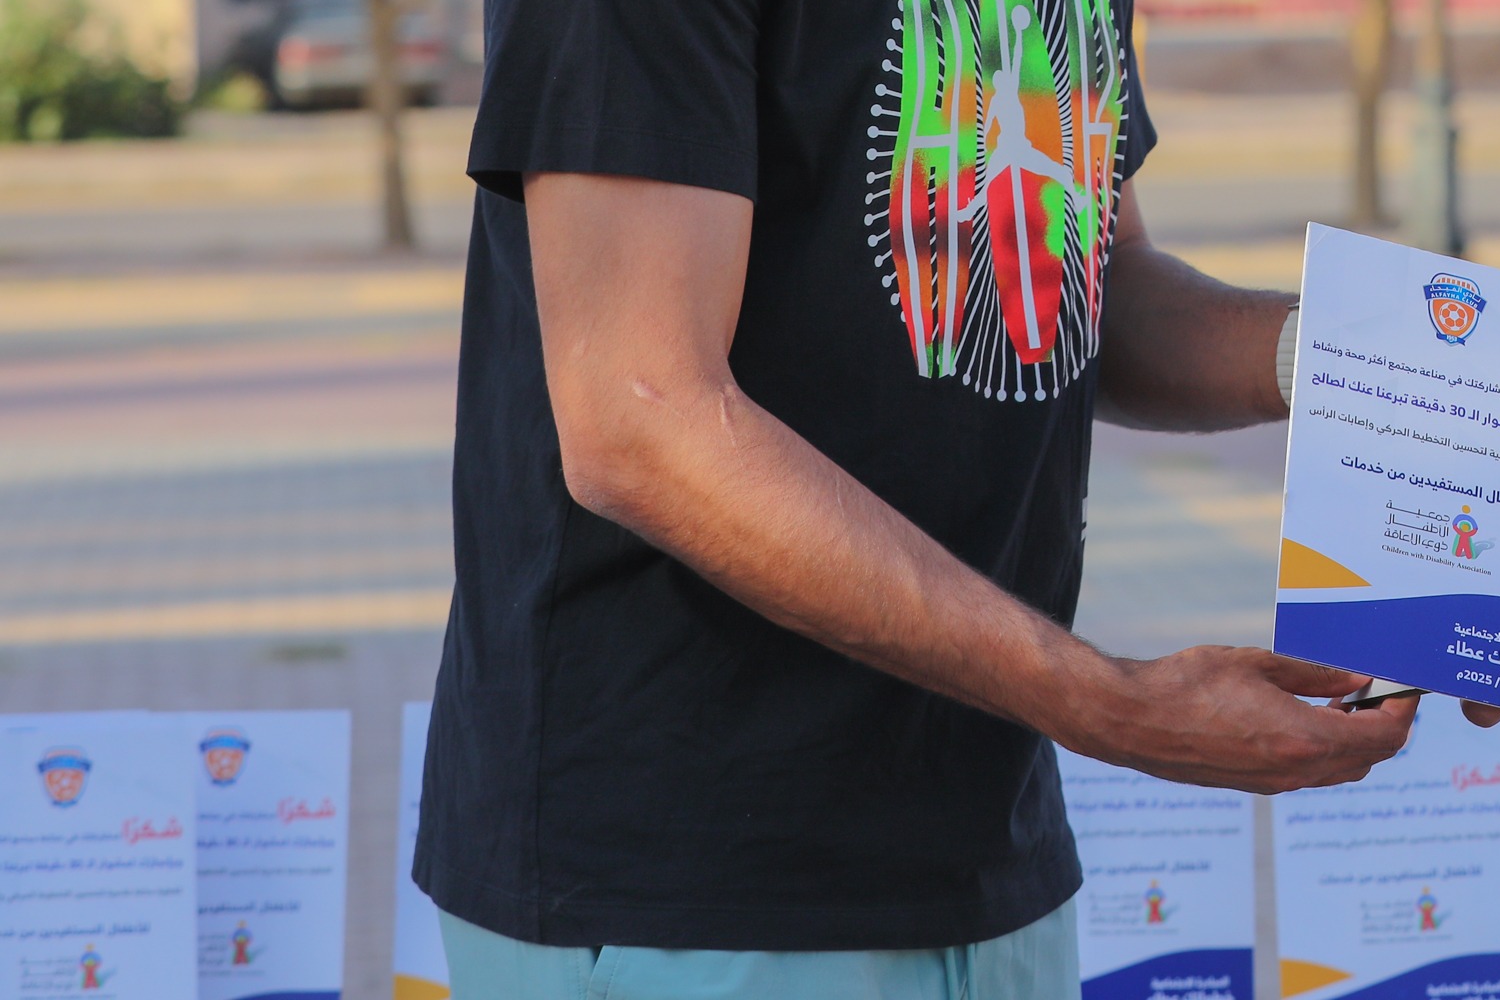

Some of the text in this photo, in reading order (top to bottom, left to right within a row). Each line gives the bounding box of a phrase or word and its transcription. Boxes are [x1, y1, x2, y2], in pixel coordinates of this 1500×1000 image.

[1431, 292, 1479, 309] ALFAYHA CLUB
[1313, 340, 1343, 357] ونشاط
[1345, 348, 1366, 361] صحة
[1367, 354, 1387, 367] أكثر
[1388, 360, 1418, 374] مجتمع
[1312, 372, 1346, 389] لصالح
[1420, 367, 1446, 381] صناعة
[1448, 374, 1462, 387] في
[1348, 381, 1373, 395] عنك
[1376, 386, 1408, 406] تبرعنا
[1411, 395, 1446, 413] دقيقة
[1450, 404, 1466, 418] 30
[1309, 405, 1336, 419] الرأس
[1338, 413, 1374, 430] وإصابات
[1376, 424, 1410, 437] الحركي
[1412, 430, 1450, 447] التخطيط
[1452, 442, 1488, 456] لتحسين
[1341, 456, 1384, 474] خدمات
[1387, 468, 1406, 480] من
[1408, 473, 1483, 499] المستفيدين
[1381, 544, 1492, 576] Children with Disability Association
[1446, 640, 1485, 661] عطاء
